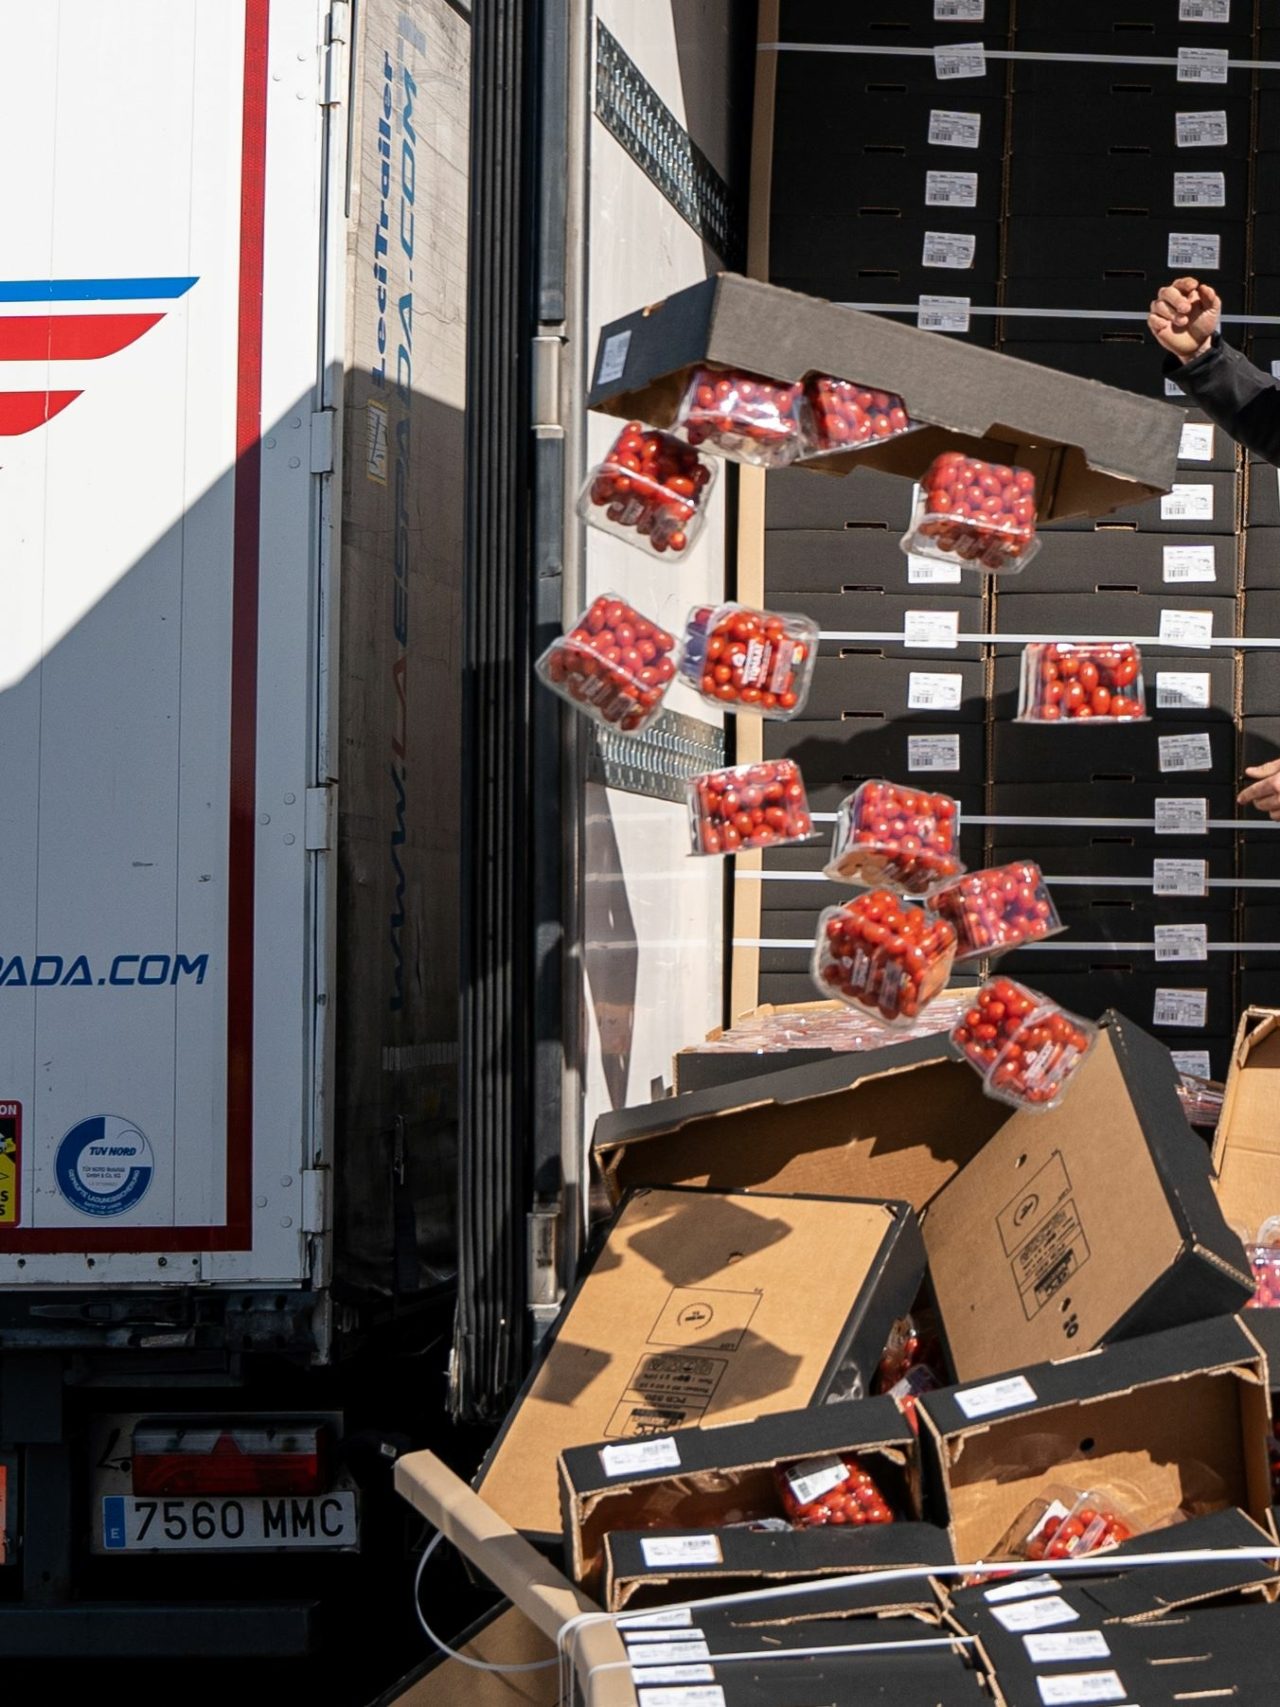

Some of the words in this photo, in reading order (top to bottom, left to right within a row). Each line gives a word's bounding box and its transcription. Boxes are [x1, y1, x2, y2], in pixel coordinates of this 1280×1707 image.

[371, 50, 393, 390] LeciTrailer
[0, 955, 209, 986] ADA.COM
[108, 1147, 137, 1156] NORD
[110, 1528, 121, 1539] E
[134, 1500, 245, 1541] 7560
[261, 1498, 344, 1538] MMC
